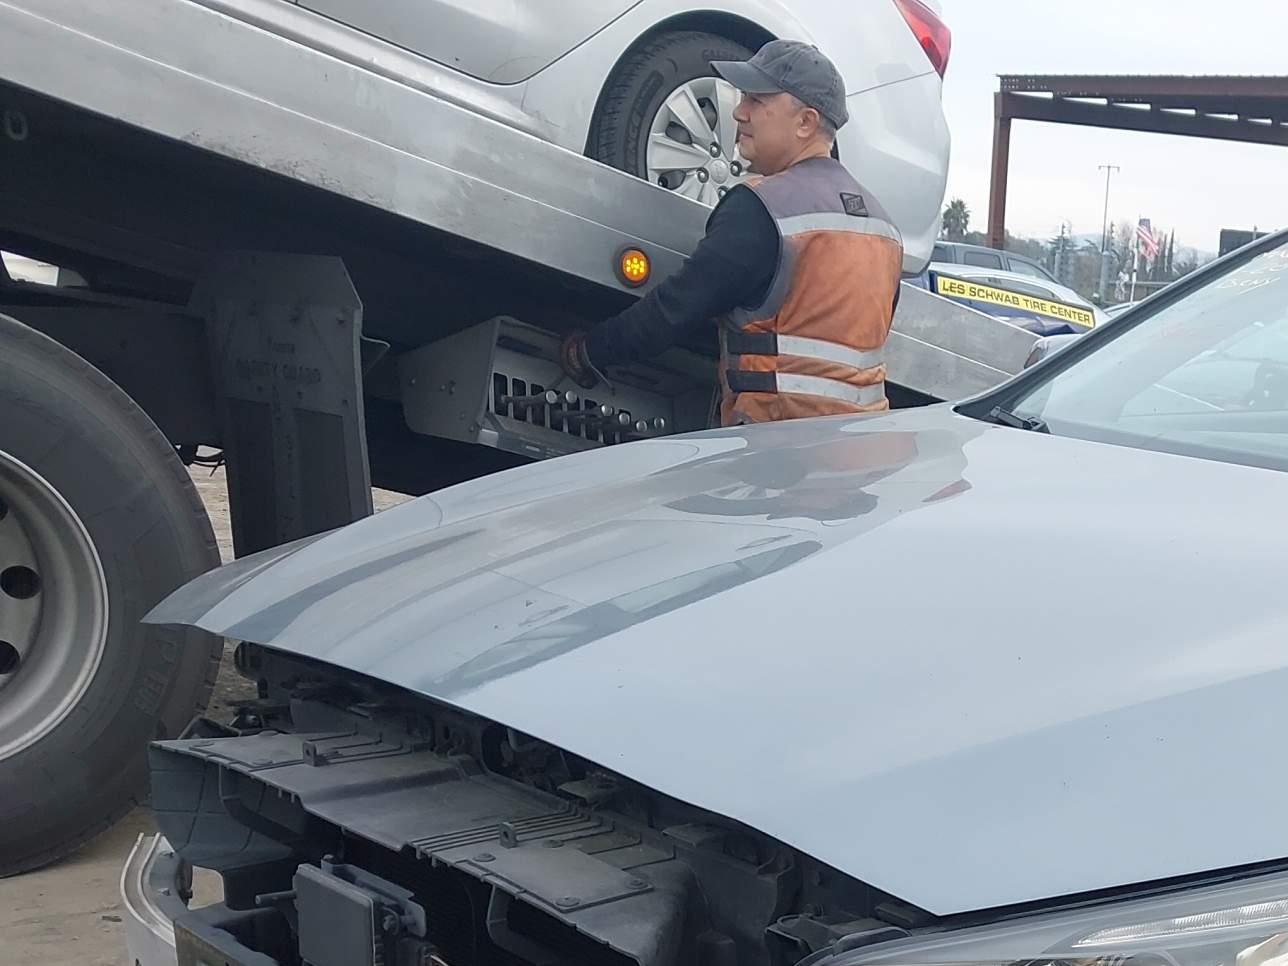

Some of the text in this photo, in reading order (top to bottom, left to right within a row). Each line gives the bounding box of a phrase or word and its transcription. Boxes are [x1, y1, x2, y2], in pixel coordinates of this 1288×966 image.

[942, 281, 1090, 324] LES SCHWAB TIRE CENTER
